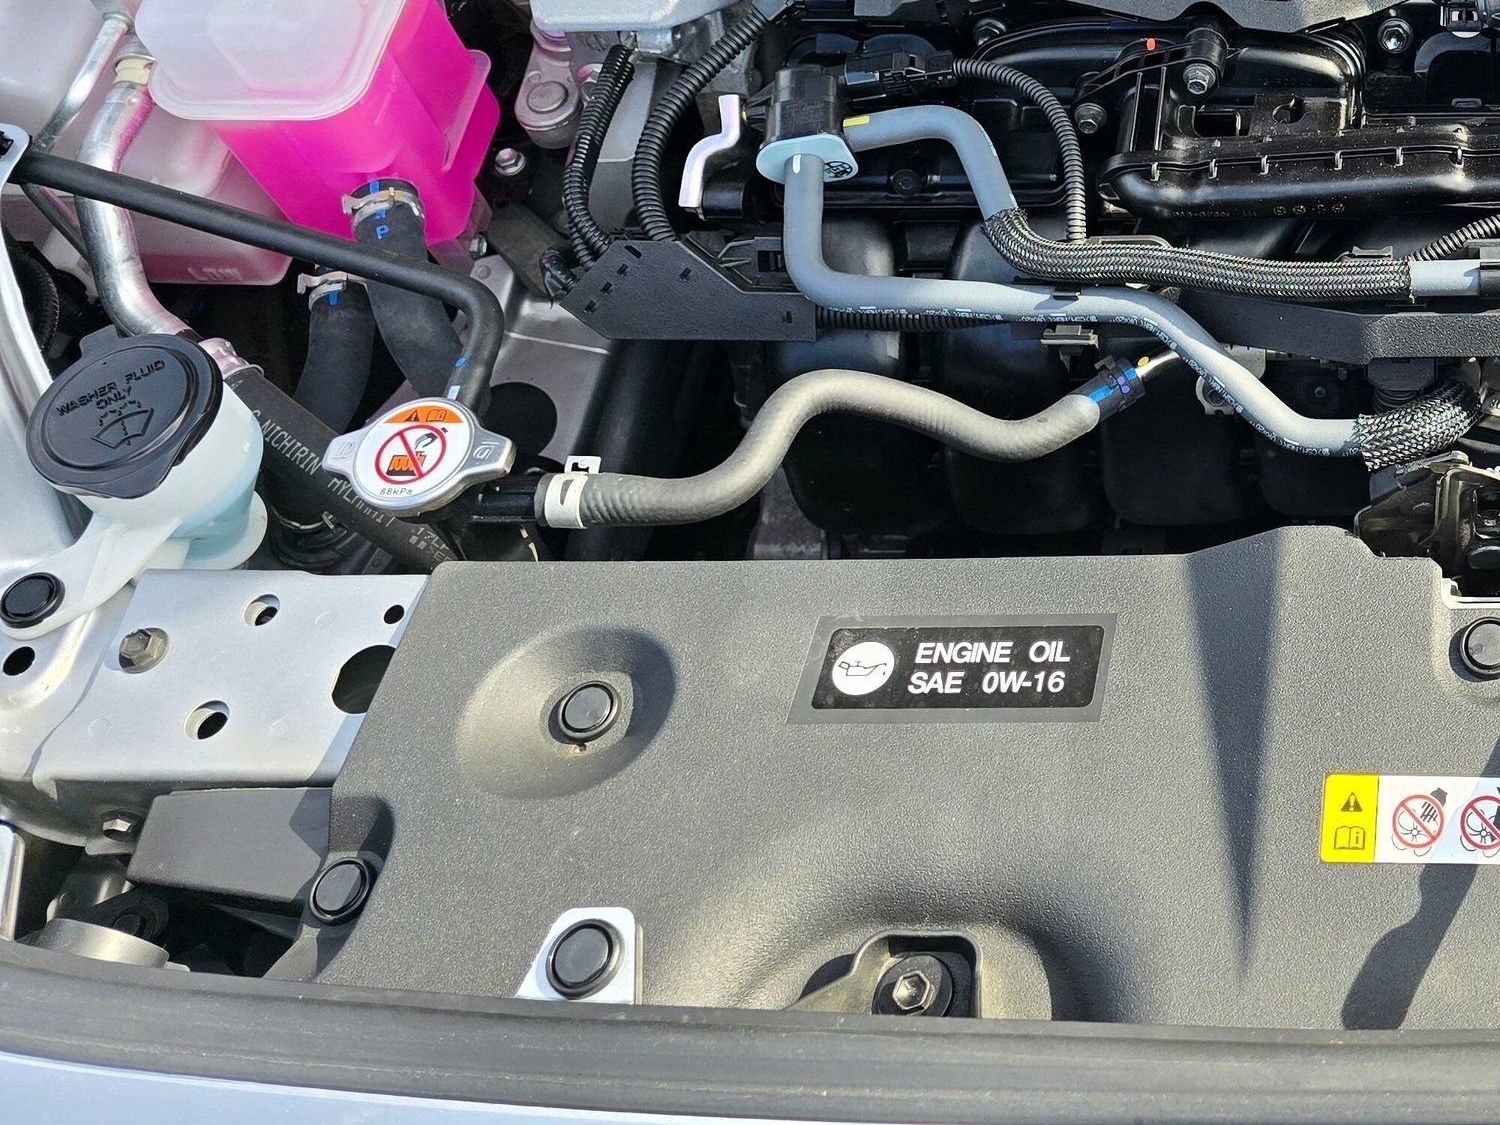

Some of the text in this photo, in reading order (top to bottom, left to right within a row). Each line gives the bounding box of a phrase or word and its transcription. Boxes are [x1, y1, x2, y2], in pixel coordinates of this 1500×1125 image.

[56, 360, 166, 416] WASHER FLUID
[95, 386, 133, 410] ONLY
[261, 419, 322, 475] NICHIRIN
[379, 486, 413, 496] 88kPa
[914, 641, 1071, 664] ENGINE OIL
[907, 671, 1067, 694] SAE 0W-16
